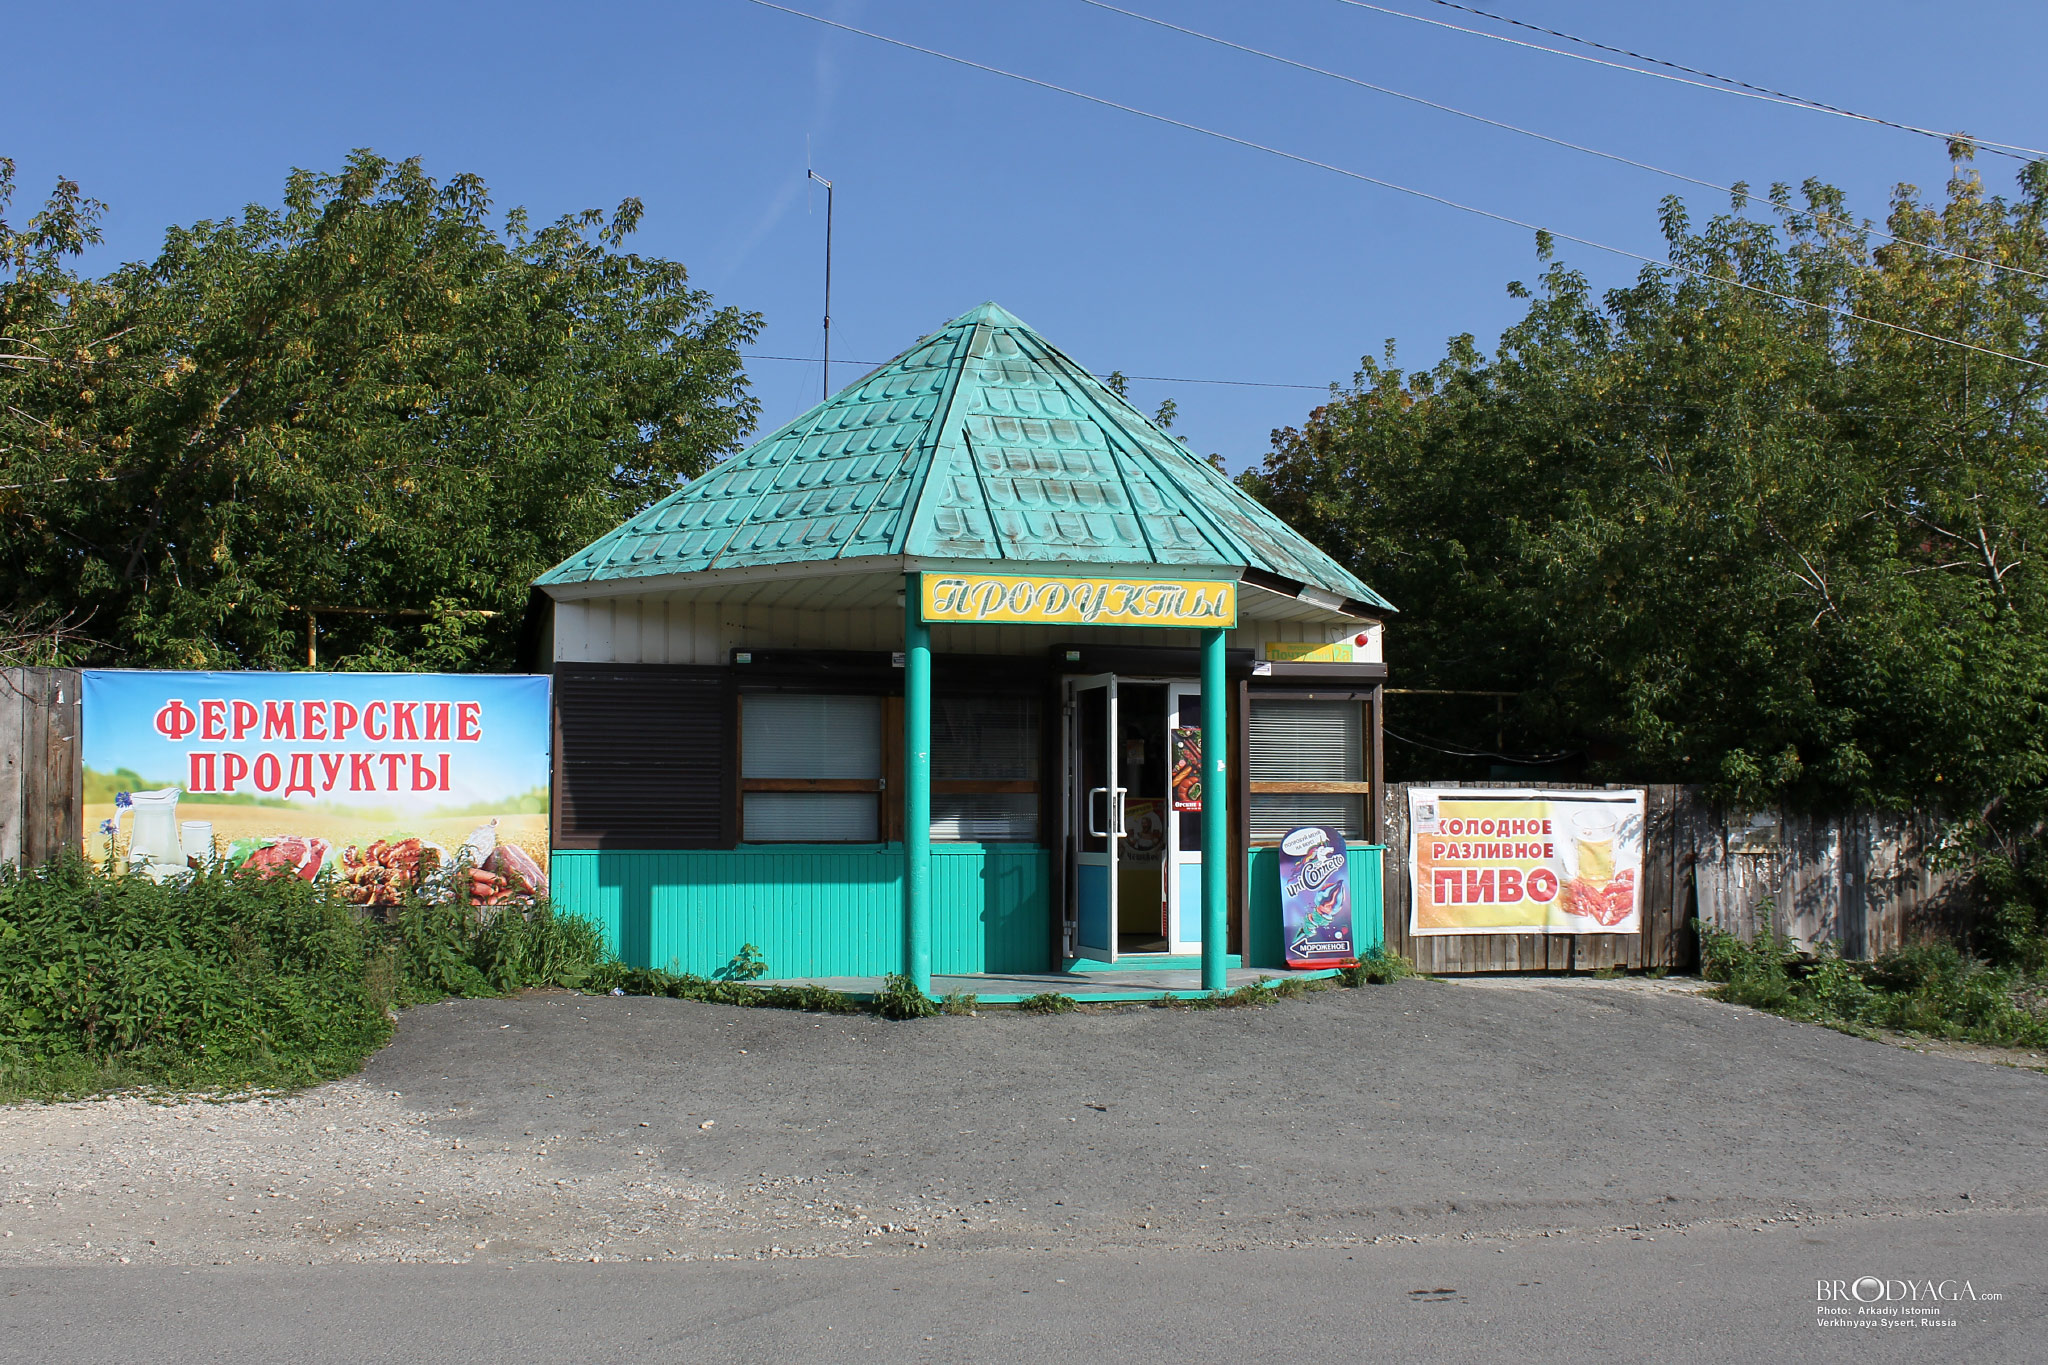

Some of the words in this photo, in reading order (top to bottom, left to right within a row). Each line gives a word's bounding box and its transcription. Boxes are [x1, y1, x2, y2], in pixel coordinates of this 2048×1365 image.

[932, 579, 1228, 622] ПРОДУКТЫ
[156, 701, 481, 741] ФЕРМЕРСКИЕ
[190, 753, 450, 798] ПРОДУКТЫ
[1433, 843, 1553, 859] РАЗЛИВНОЕ
[1434, 868, 1558, 903] ПИВО
[1299, 943, 1346, 952] МОРОЖЕНОЕ
